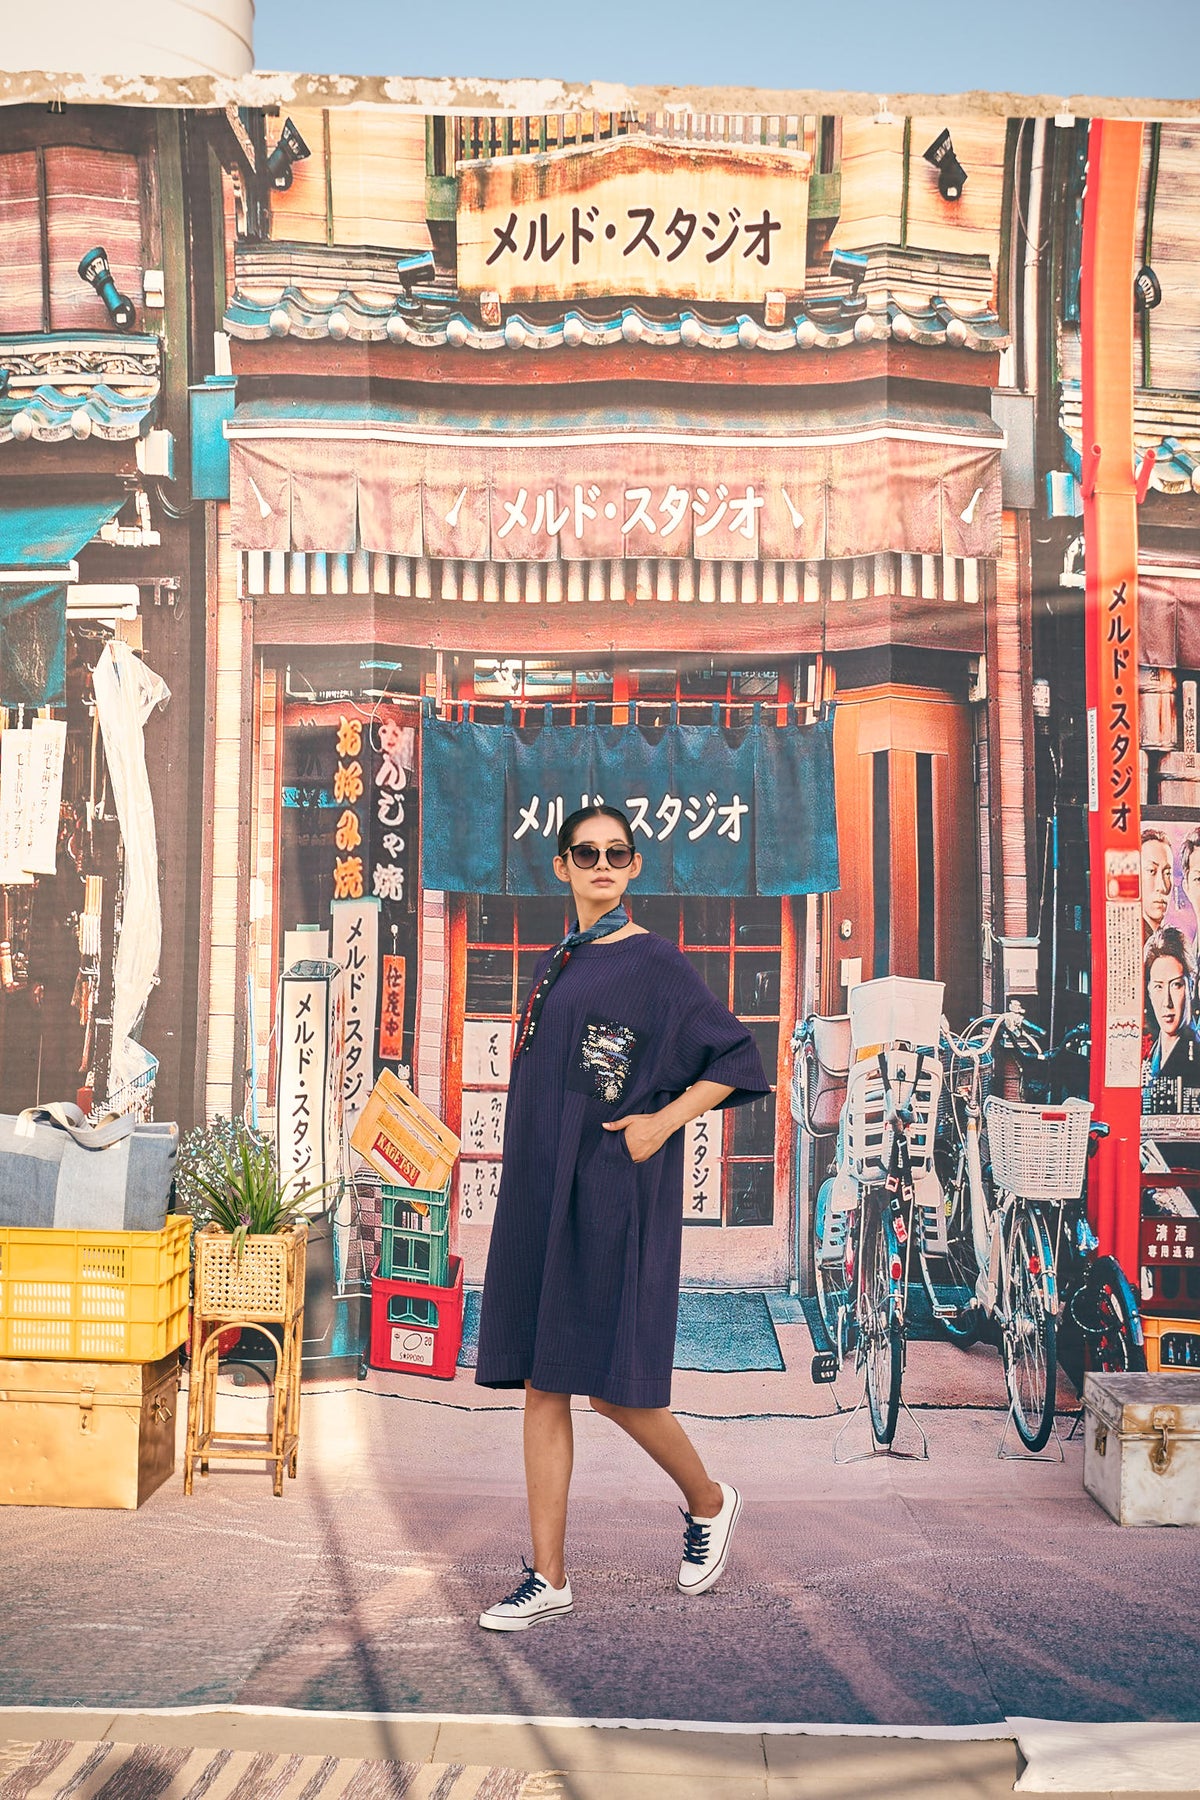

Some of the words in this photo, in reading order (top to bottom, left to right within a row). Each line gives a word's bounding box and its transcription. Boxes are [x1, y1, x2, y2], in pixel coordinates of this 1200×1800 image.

[485, 205, 782, 266] メルド・スタジオ
[497, 483, 765, 539] メルド・スタジオ
[1107, 581, 1132, 833] メルド・スタジオ
[512, 791, 750, 843] メルスタジオ
[292, 993, 315, 1200] メルド・スタジオ
[376, 1134, 419, 1181] KAGETSU
[1155, 1223, 1188, 1242] 清酒
